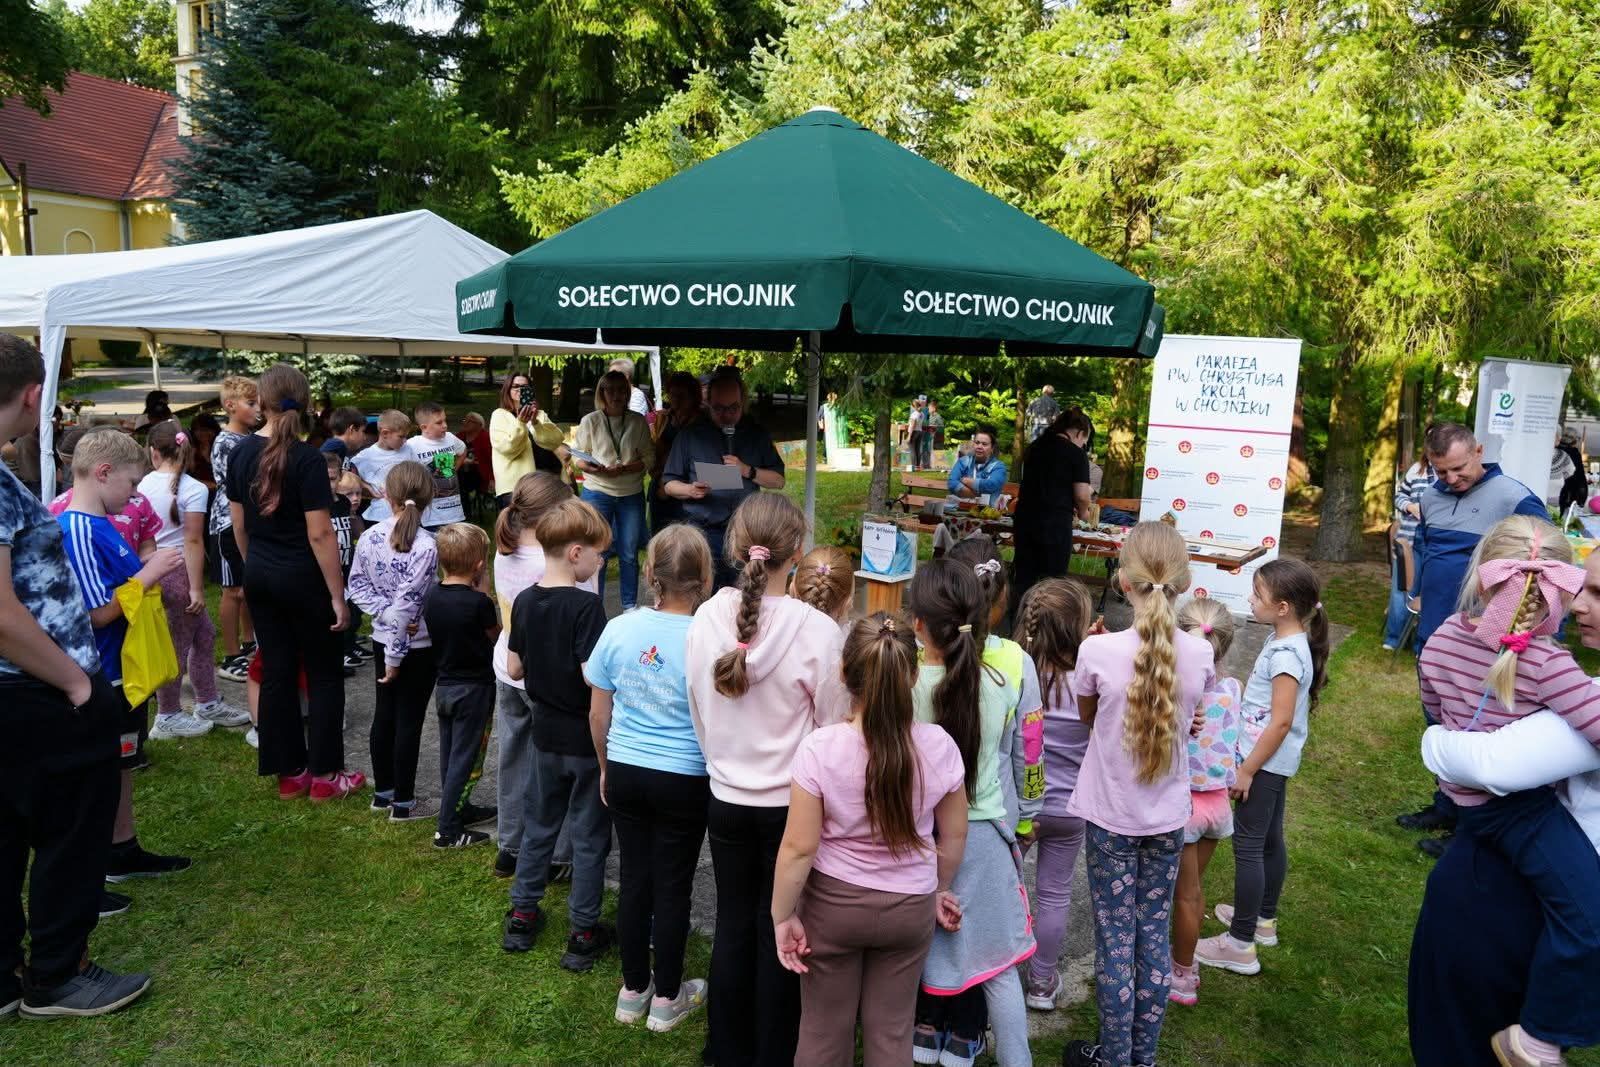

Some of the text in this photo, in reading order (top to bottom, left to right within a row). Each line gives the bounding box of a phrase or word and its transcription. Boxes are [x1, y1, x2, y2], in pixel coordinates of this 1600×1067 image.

[558, 283, 797, 308] SOŁECTWO CHOJNIK
[902, 289, 1115, 326] SOŁECTWO CHOJNIK
[1196, 355, 1258, 371] PARAFIA
[1199, 369, 1284, 387] CHRYSTUSA
[1193, 397, 1271, 417] CHOJNIKU
